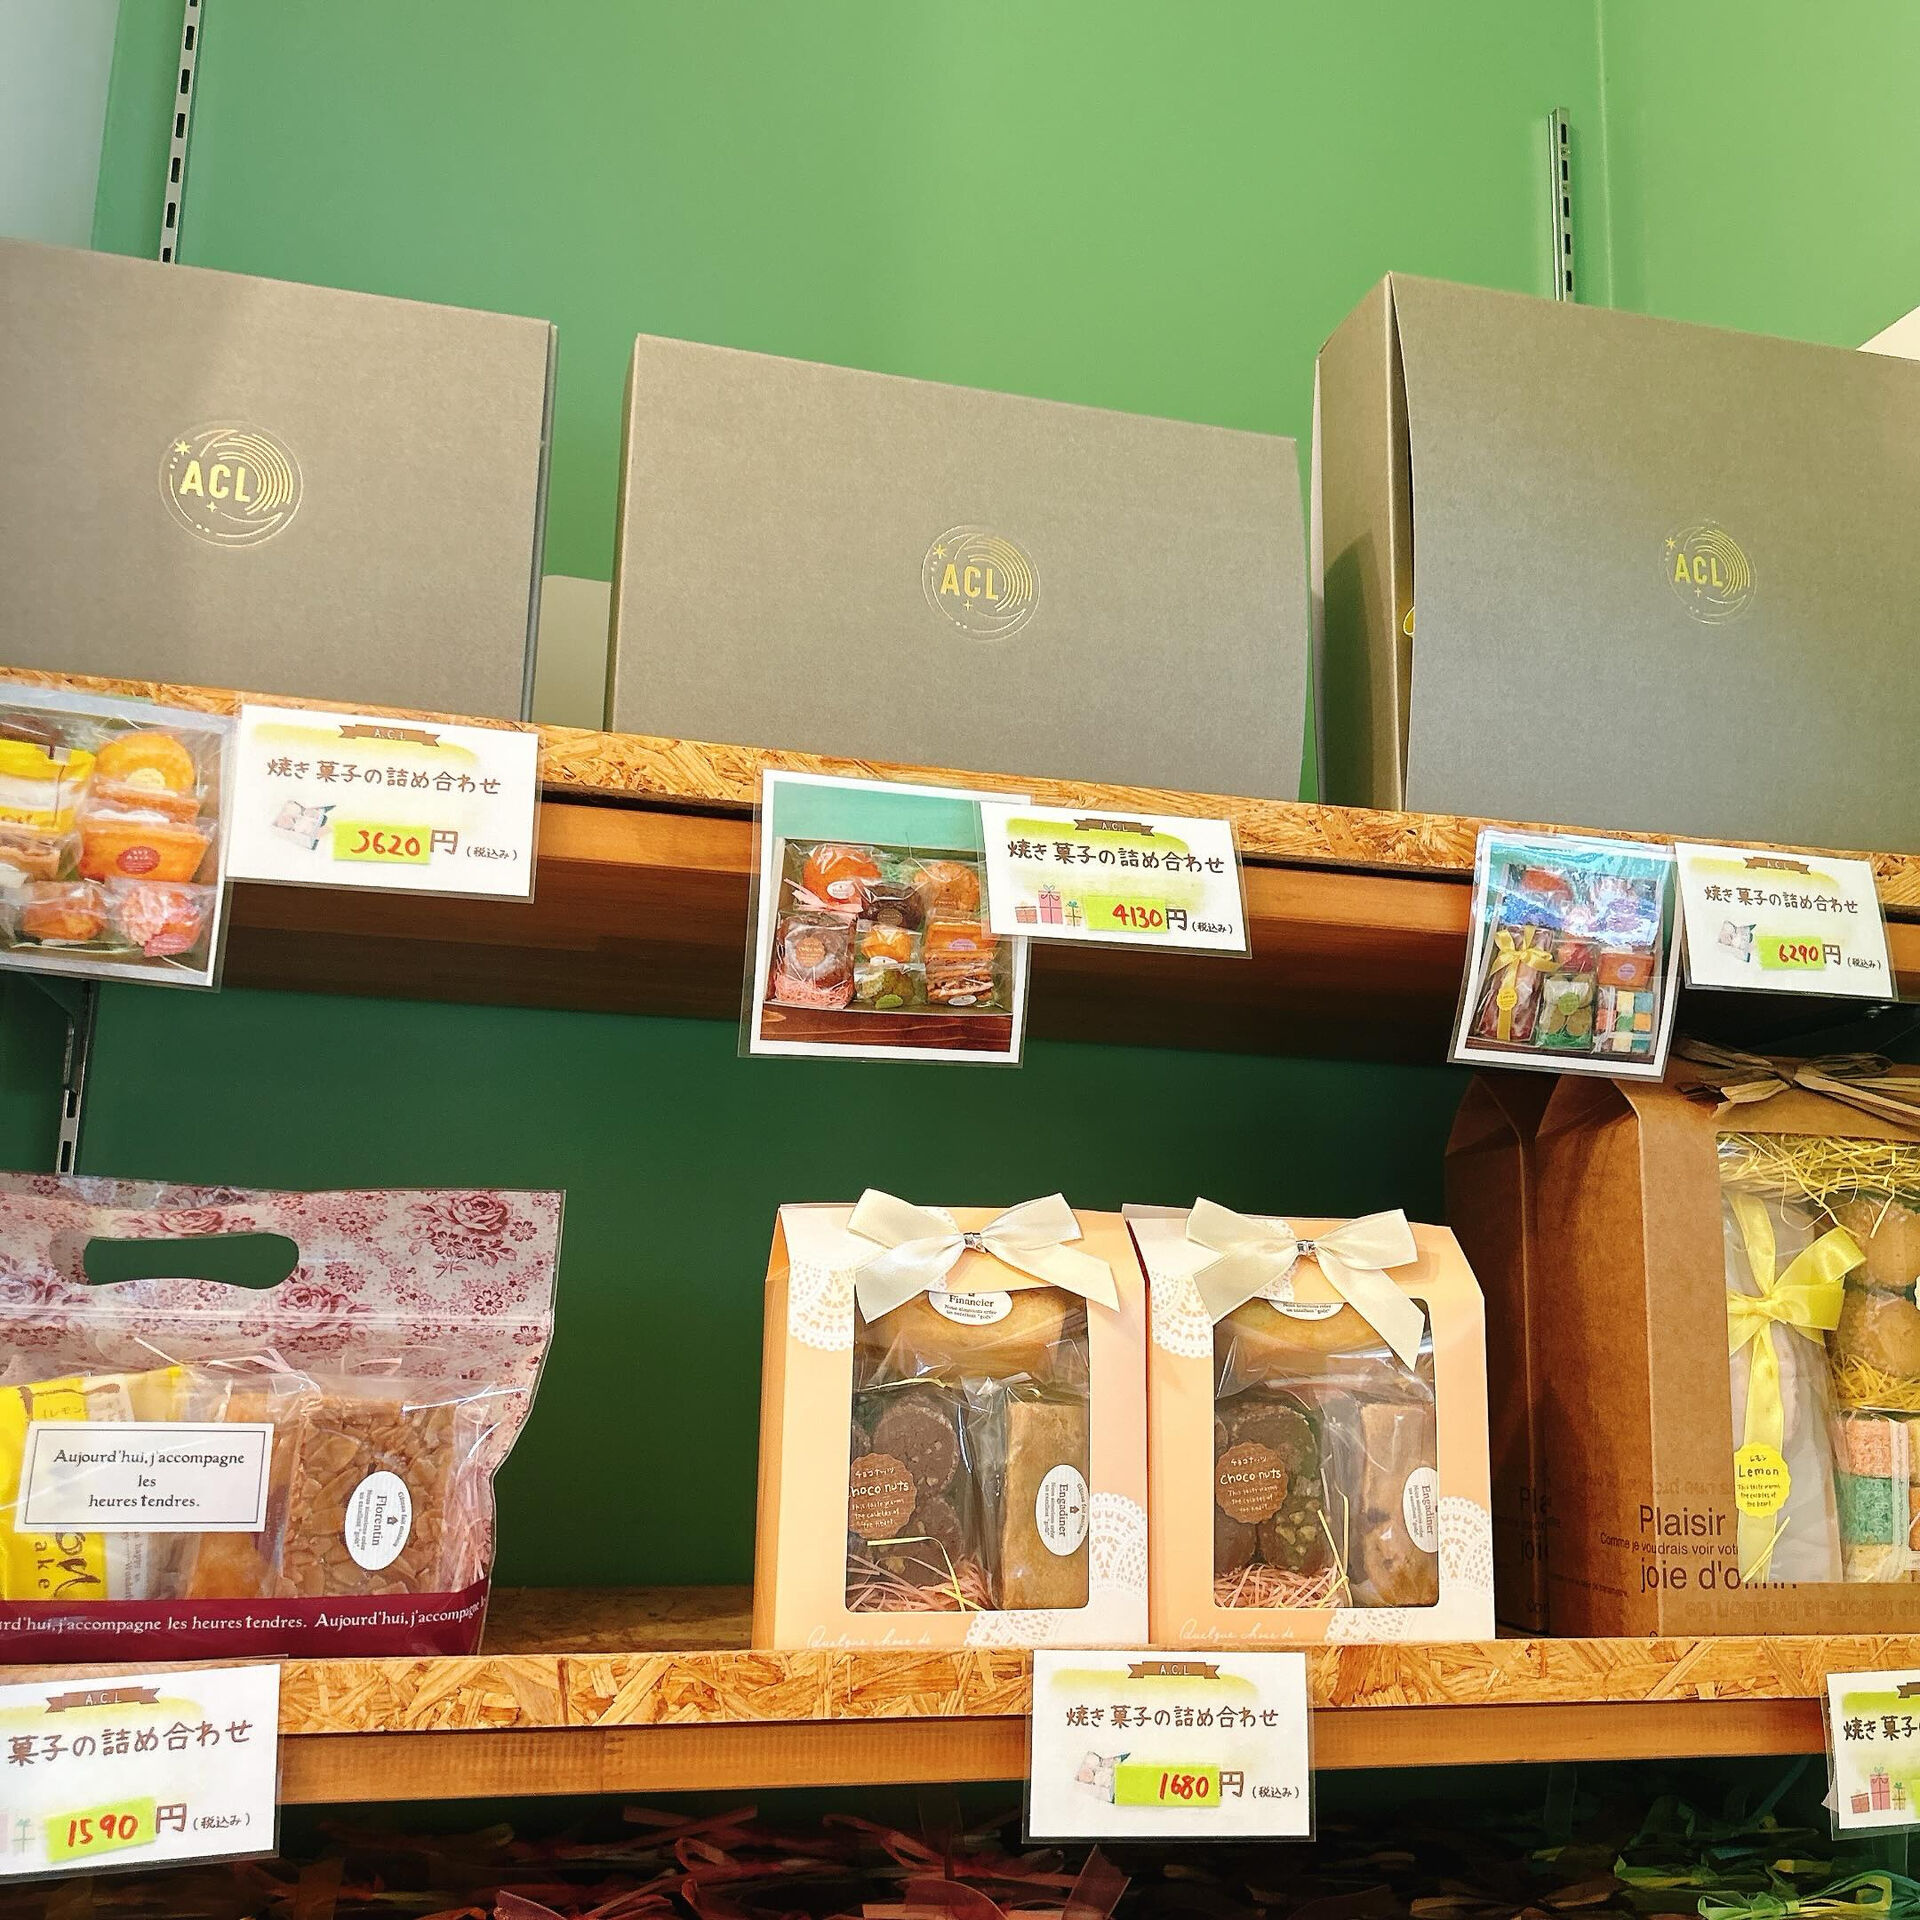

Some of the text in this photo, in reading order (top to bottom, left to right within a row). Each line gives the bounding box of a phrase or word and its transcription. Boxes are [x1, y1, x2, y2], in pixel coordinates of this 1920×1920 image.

[179, 460, 250, 502] ACL
[940, 563, 999, 600] ACL
[1674, 553, 1723, 587] ACL
[267, 757, 501, 795] 焼き菓子の詰め合わせ
[1007, 838, 1225, 874] 焼き菓子の詰め合わせ
[1704, 884, 1859, 914] 焼き菓子の詰め合わせ
[949, 1294, 994, 1307] Financier
[138, 1475, 157, 1487] les
[1259, 1468, 1281, 1479] nuts
[1738, 1464, 1779, 1478] Lemon
[89, 1494, 200, 1507] heures tendres.
[848, 1480, 910, 1498] hoco nuts
[372, 1495, 388, 1546] Florentin
[1057, 1484, 1069, 1537] Engadiner
[1422, 1485, 1435, 1535] Engadiner
[1639, 1504, 1726, 1537] Plaisir
[1600, 1532, 1630, 1550] Comme
[1631, 1539, 1640, 1553] je
[1641, 1539, 1689, 1556] voudrais
[1692, 1542, 1714, 1556] voir
[33, 1541, 55, 1589] ake
[1640, 1556, 1687, 1594] joie
[167, 1615, 188, 1630] les
[191, 1615, 243, 1630] heures
[245, 1615, 307, 1629] tendres.
[1066, 1704, 1279, 1729] 焼き菓子の詰め合わせ
[1843, 1715, 1920, 1741] 焼き菓子
